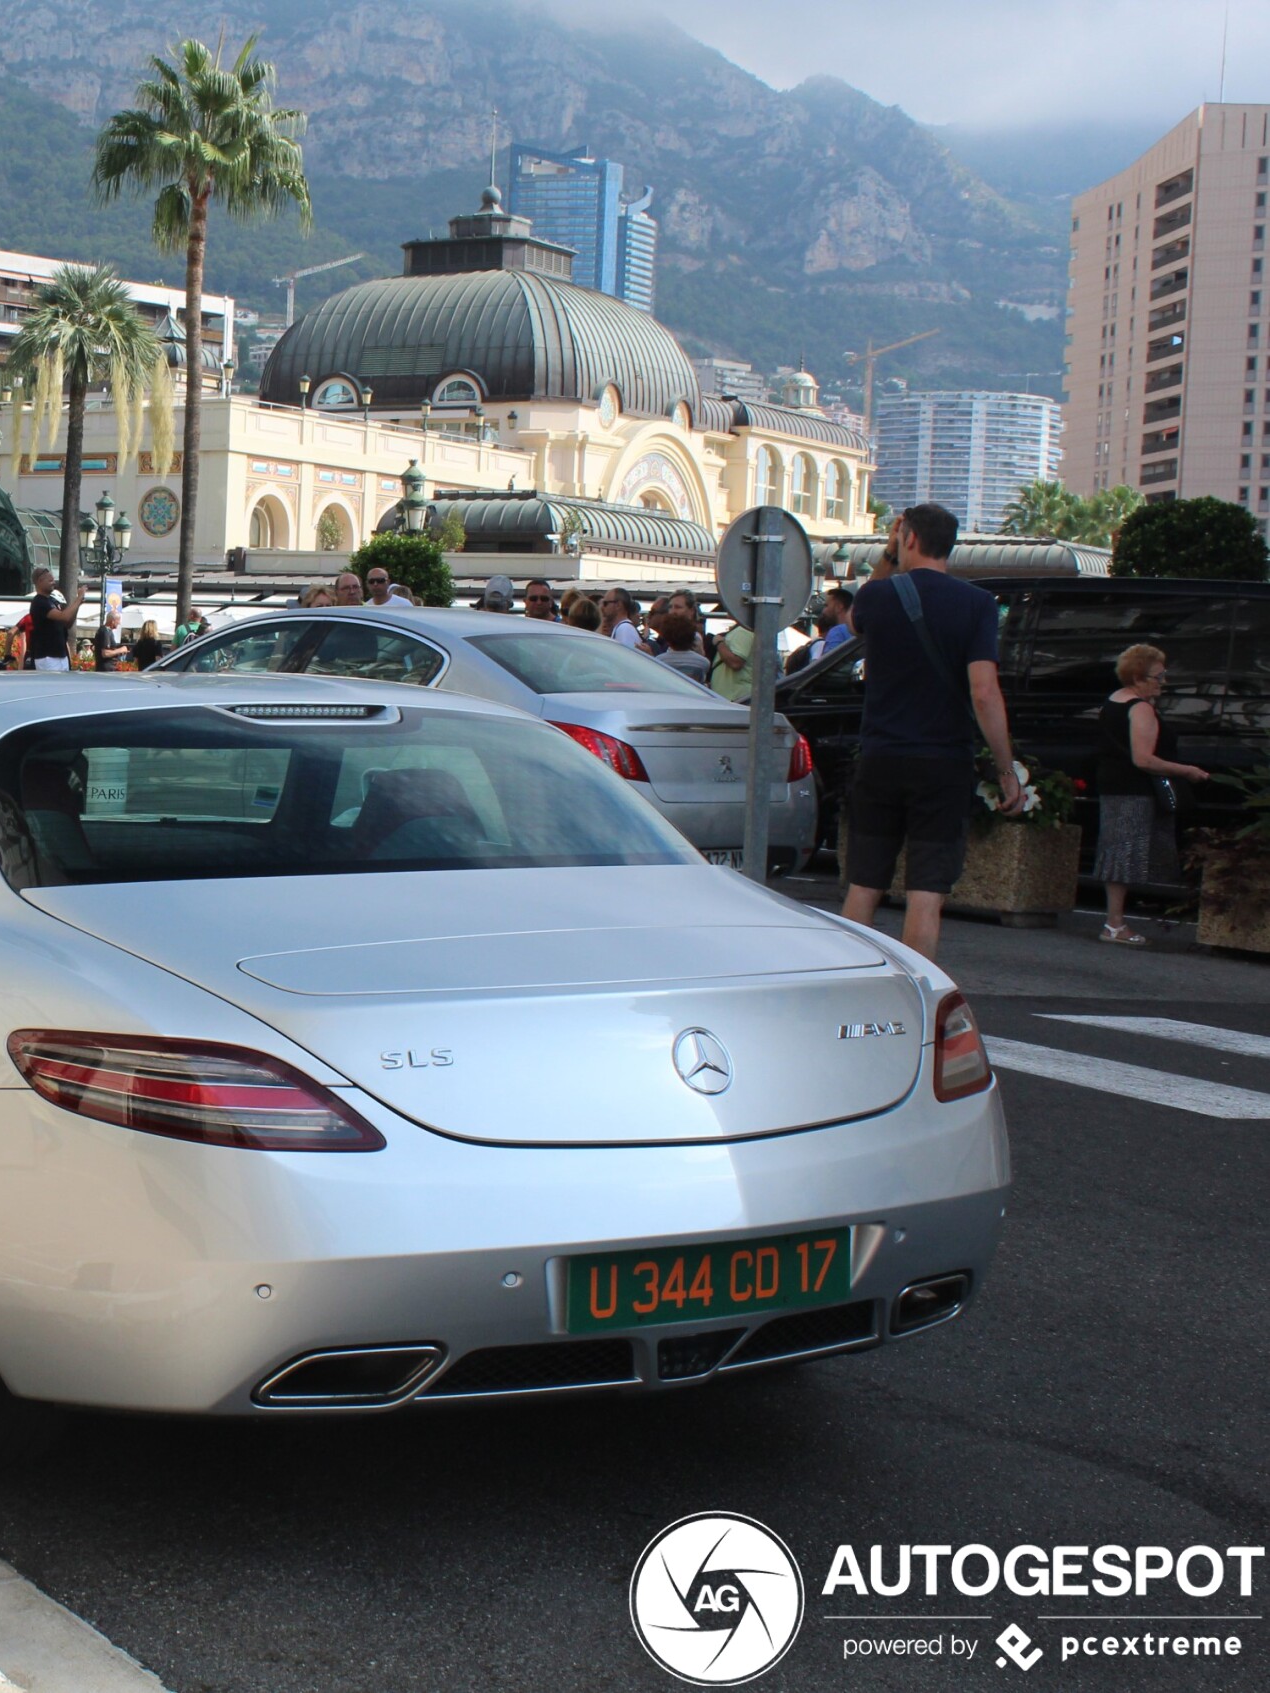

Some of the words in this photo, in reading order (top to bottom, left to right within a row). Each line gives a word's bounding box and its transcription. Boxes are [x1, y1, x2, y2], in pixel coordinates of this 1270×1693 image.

[91, 787, 126, 800] PARIS
[380, 1048, 454, 1070] SLS
[590, 1264, 618, 1319] U
[633, 1254, 714, 1314] 344
[730, 1246, 779, 1302] CD
[796, 1239, 837, 1293] 17
